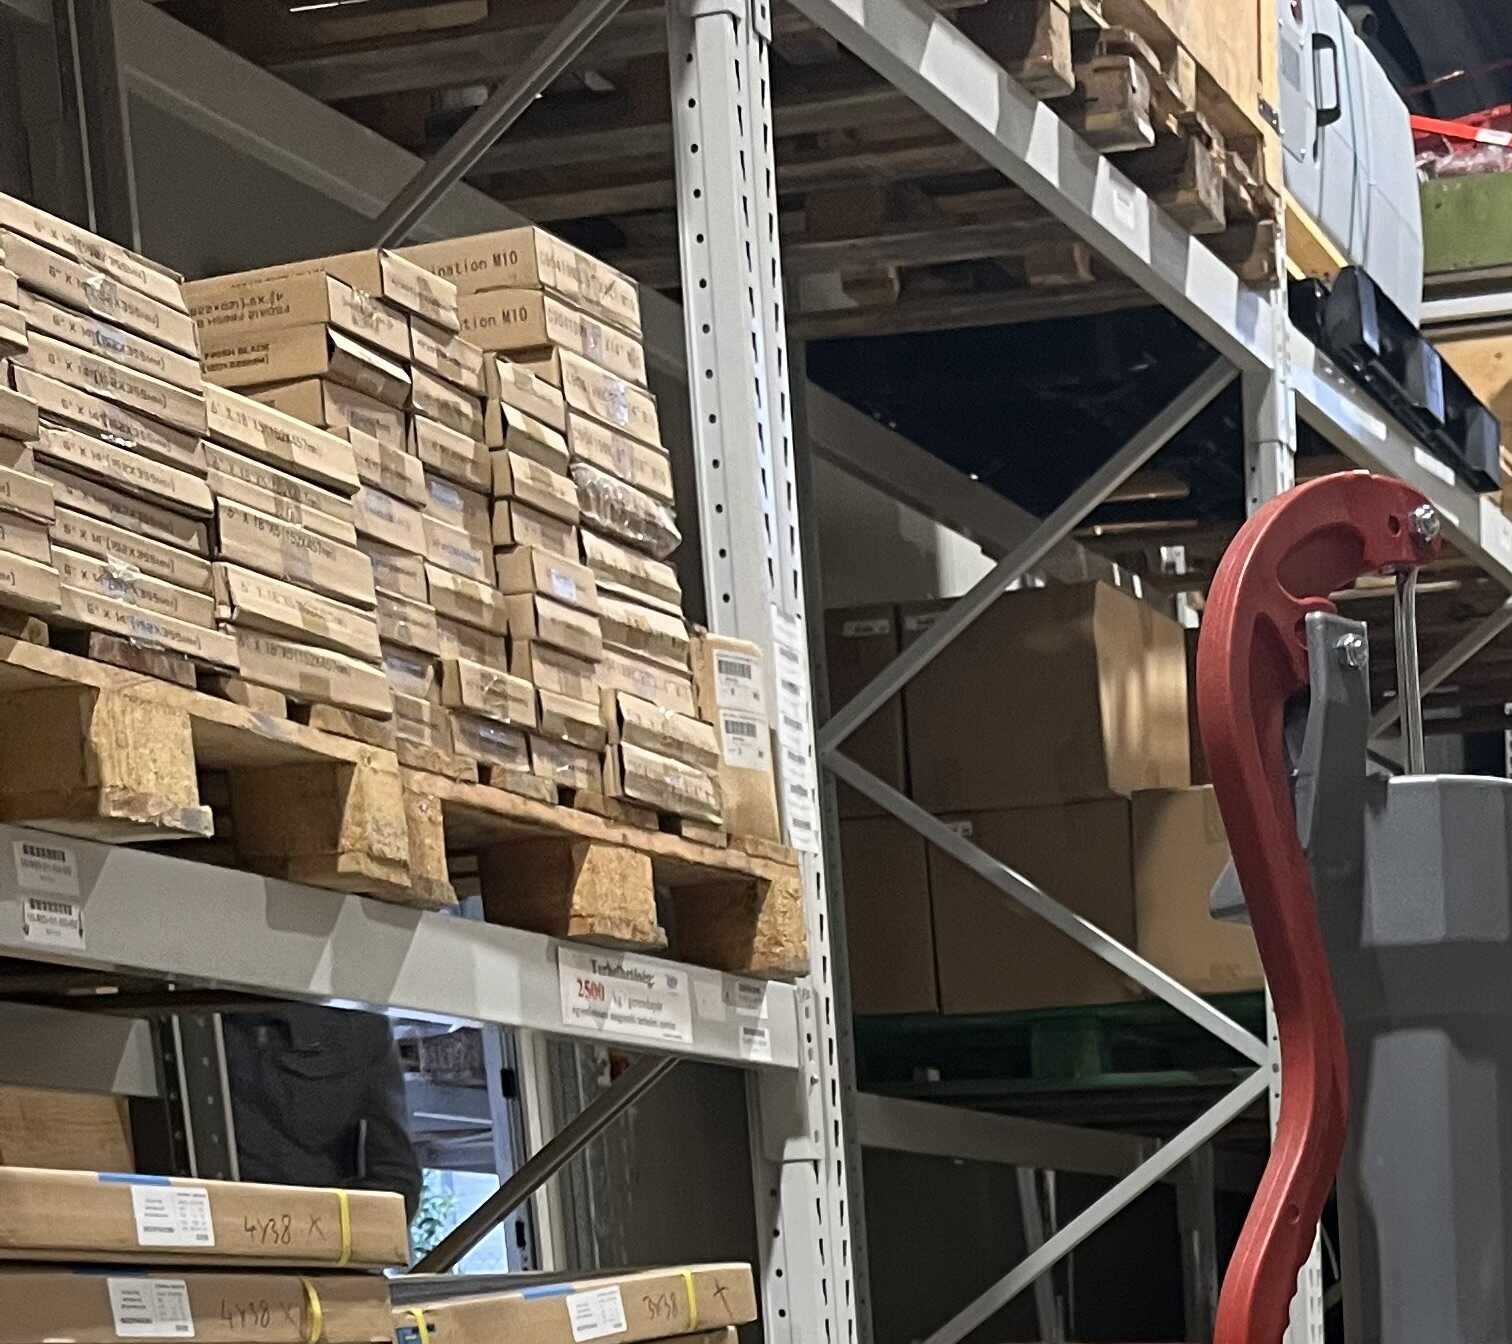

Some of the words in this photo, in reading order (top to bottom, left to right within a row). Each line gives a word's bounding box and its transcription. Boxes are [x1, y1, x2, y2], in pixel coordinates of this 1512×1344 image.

[493, 250, 518, 267] M10
[502, 307, 528, 324] M10
[576, 978, 605, 1001] 2500
